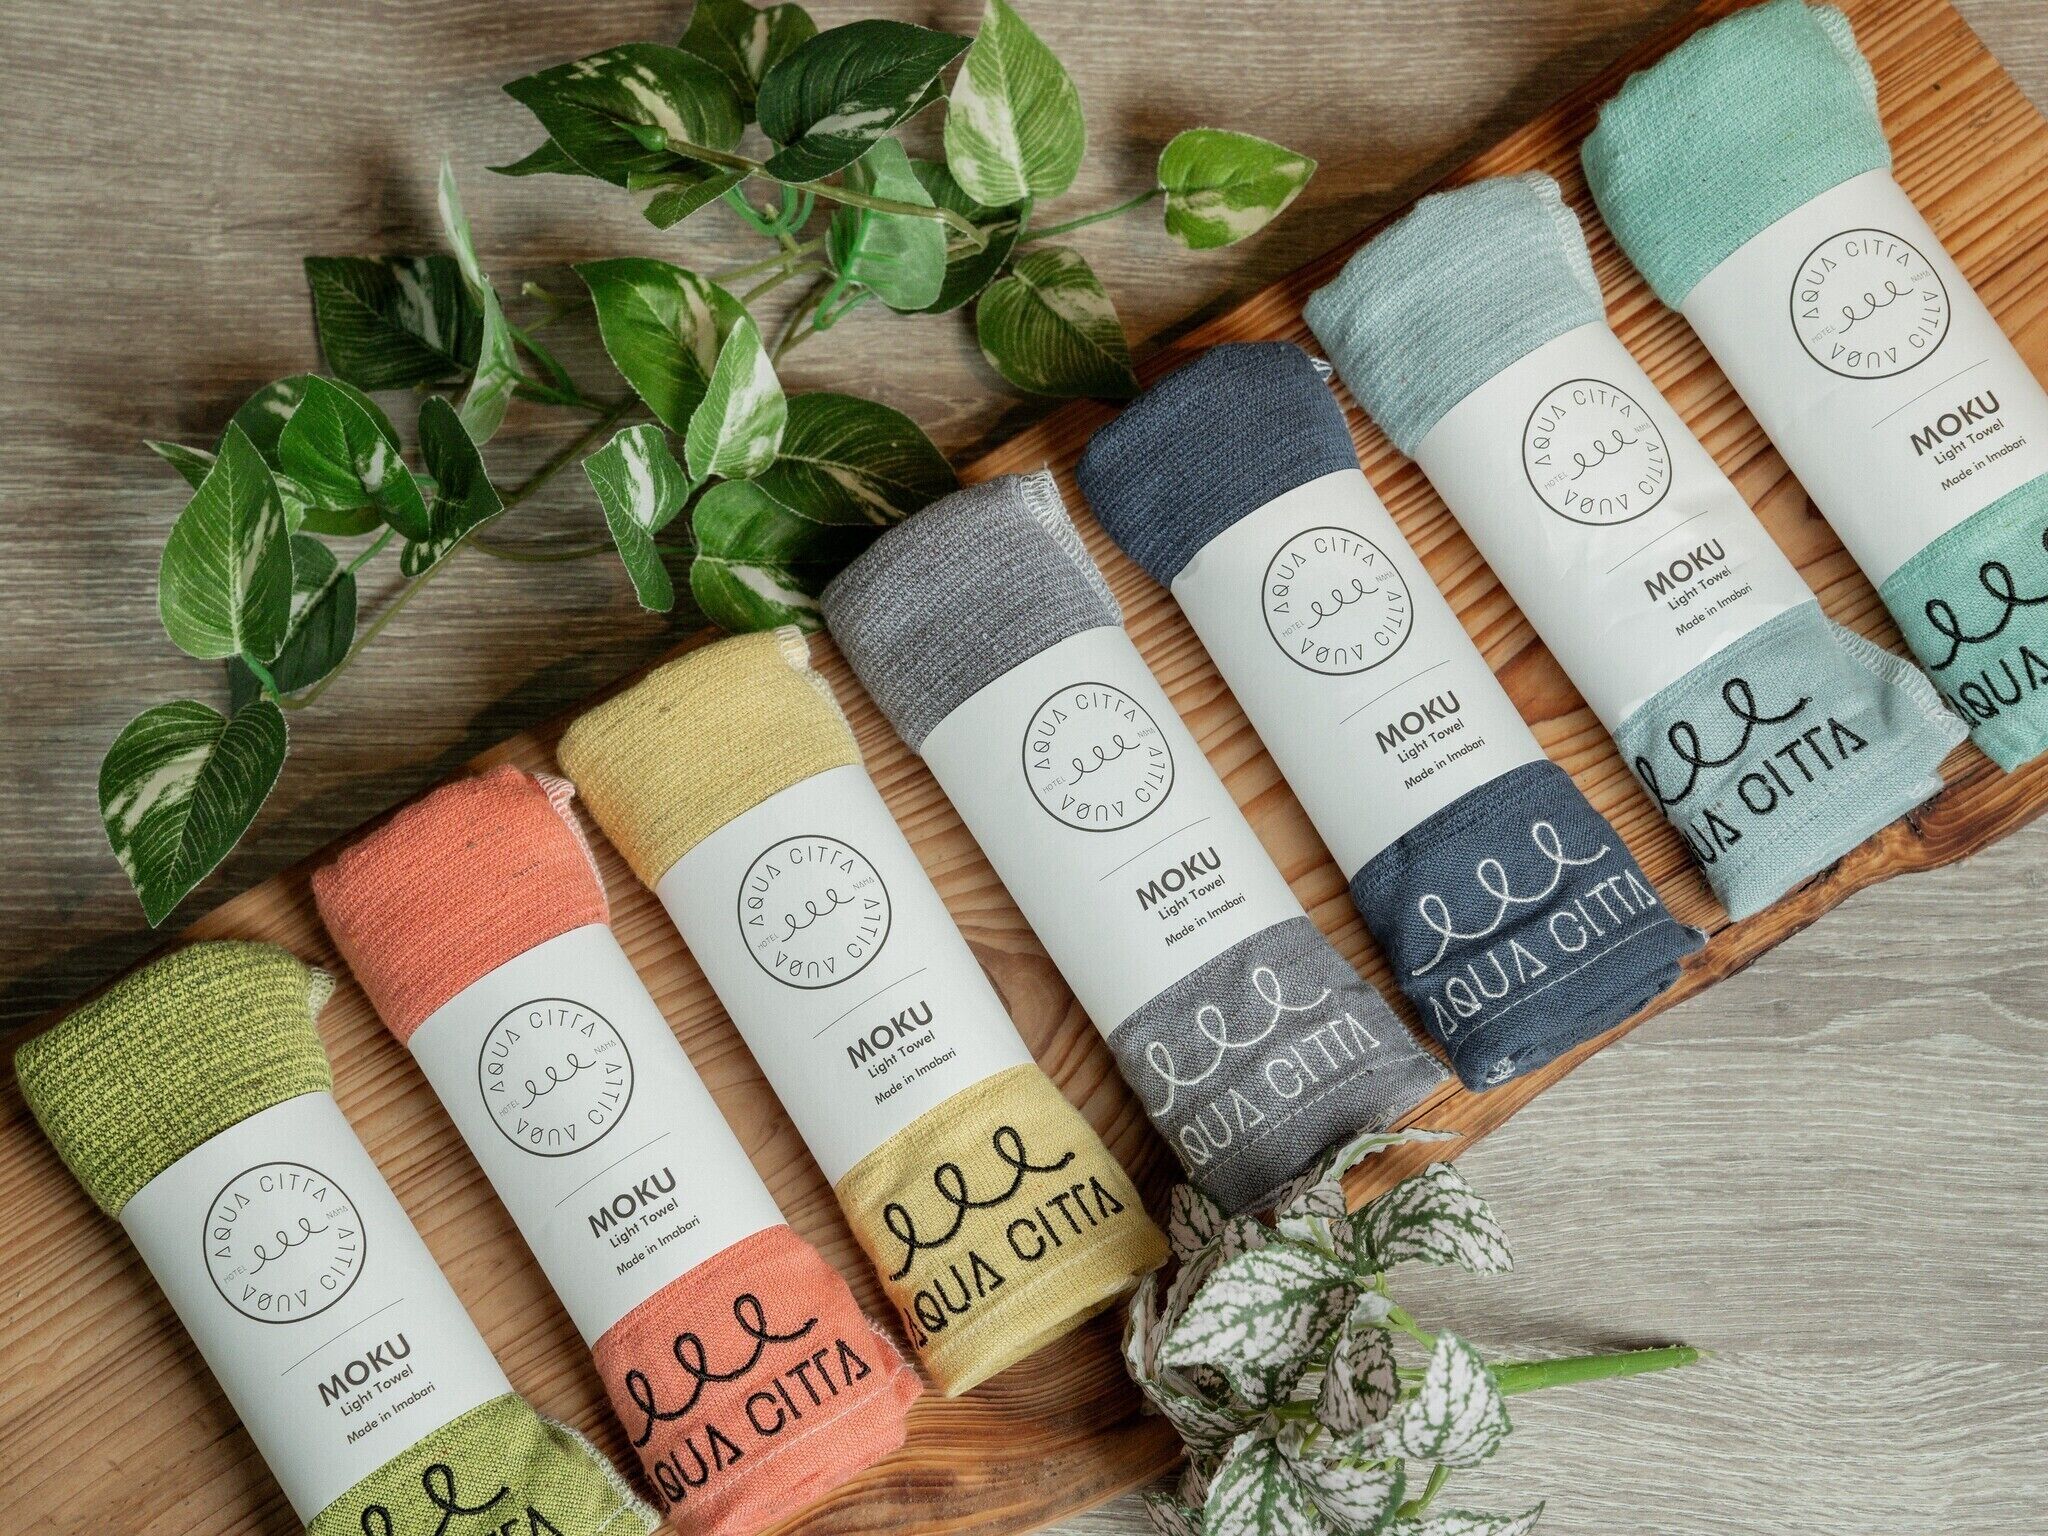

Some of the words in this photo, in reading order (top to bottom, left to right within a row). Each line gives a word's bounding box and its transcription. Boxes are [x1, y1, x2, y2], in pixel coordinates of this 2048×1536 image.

[1801, 258, 1837, 318] AQUA
[1533, 405, 1566, 465] AQUA
[1910, 390, 2000, 456] MOKU
[1934, 441, 1966, 465] Light
[1966, 418, 2004, 443] Towel
[1941, 469, 1972, 490] Made
[1973, 461, 1986, 470] in
[1985, 436, 2026, 462] Imabari
[1272, 553, 1306, 613] AQUA
[1644, 538, 1725, 602] MOKU
[1668, 587, 1698, 610] Light
[1697, 565, 1731, 589] Towel
[1282, 620, 1304, 637] HOTEL
[1676, 614, 1705, 636] Made
[1705, 607, 1717, 616] in
[1717, 583, 1752, 608] Imabari
[1033, 709, 1067, 769] AQUA
[1375, 690, 1460, 754] MOKU
[1397, 740, 1428, 763] Light
[1428, 718, 1464, 742] Towel
[1042, 776, 1066, 794] HOTEL
[1404, 768, 1434, 789] Made
[1434, 760, 1447, 769] in
[1446, 737, 1485, 762] Imabari
[748, 865, 781, 926] AQUA
[1136, 847, 1221, 911] MOKU
[1158, 897, 1189, 920] Light
[1189, 874, 1225, 899] Towel
[757, 933, 779, 950] HOTEL
[1165, 925, 1195, 946] Made
[1194, 917, 1207, 926] in
[1207, 893, 1246, 919] Imabari
[1429, 939, 1547, 1041] AQUA
[488, 1029, 520, 1092] AQUA
[847, 1000, 933, 1069] MOKU
[868, 1054, 897, 1078] Light
[897, 1030, 935, 1057] Towel
[875, 1083, 902, 1105] Made
[903, 1075, 915, 1084] in
[915, 1048, 956, 1077] Imabari
[499, 1099, 519, 1116] HOTEL
[214, 1193, 250, 1258] AQUA
[588, 1167, 676, 1238] MOKU
[610, 1223, 639, 1248] Light
[639, 1198, 678, 1226] Towel
[224, 1265, 247, 1284] HOTEL
[617, 1253, 645, 1275] Made
[645, 1245, 657, 1254] in
[658, 1215, 700, 1246] Imabari
[318, 1333, 410, 1407] MOKU
[341, 1390, 373, 1416] Light
[373, 1364, 413, 1393] Towel
[347, 1421, 378, 1444] Made
[379, 1412, 391, 1422] in
[392, 1382, 435, 1413] Imabari
[654, 1423, 744, 1513] QUA
